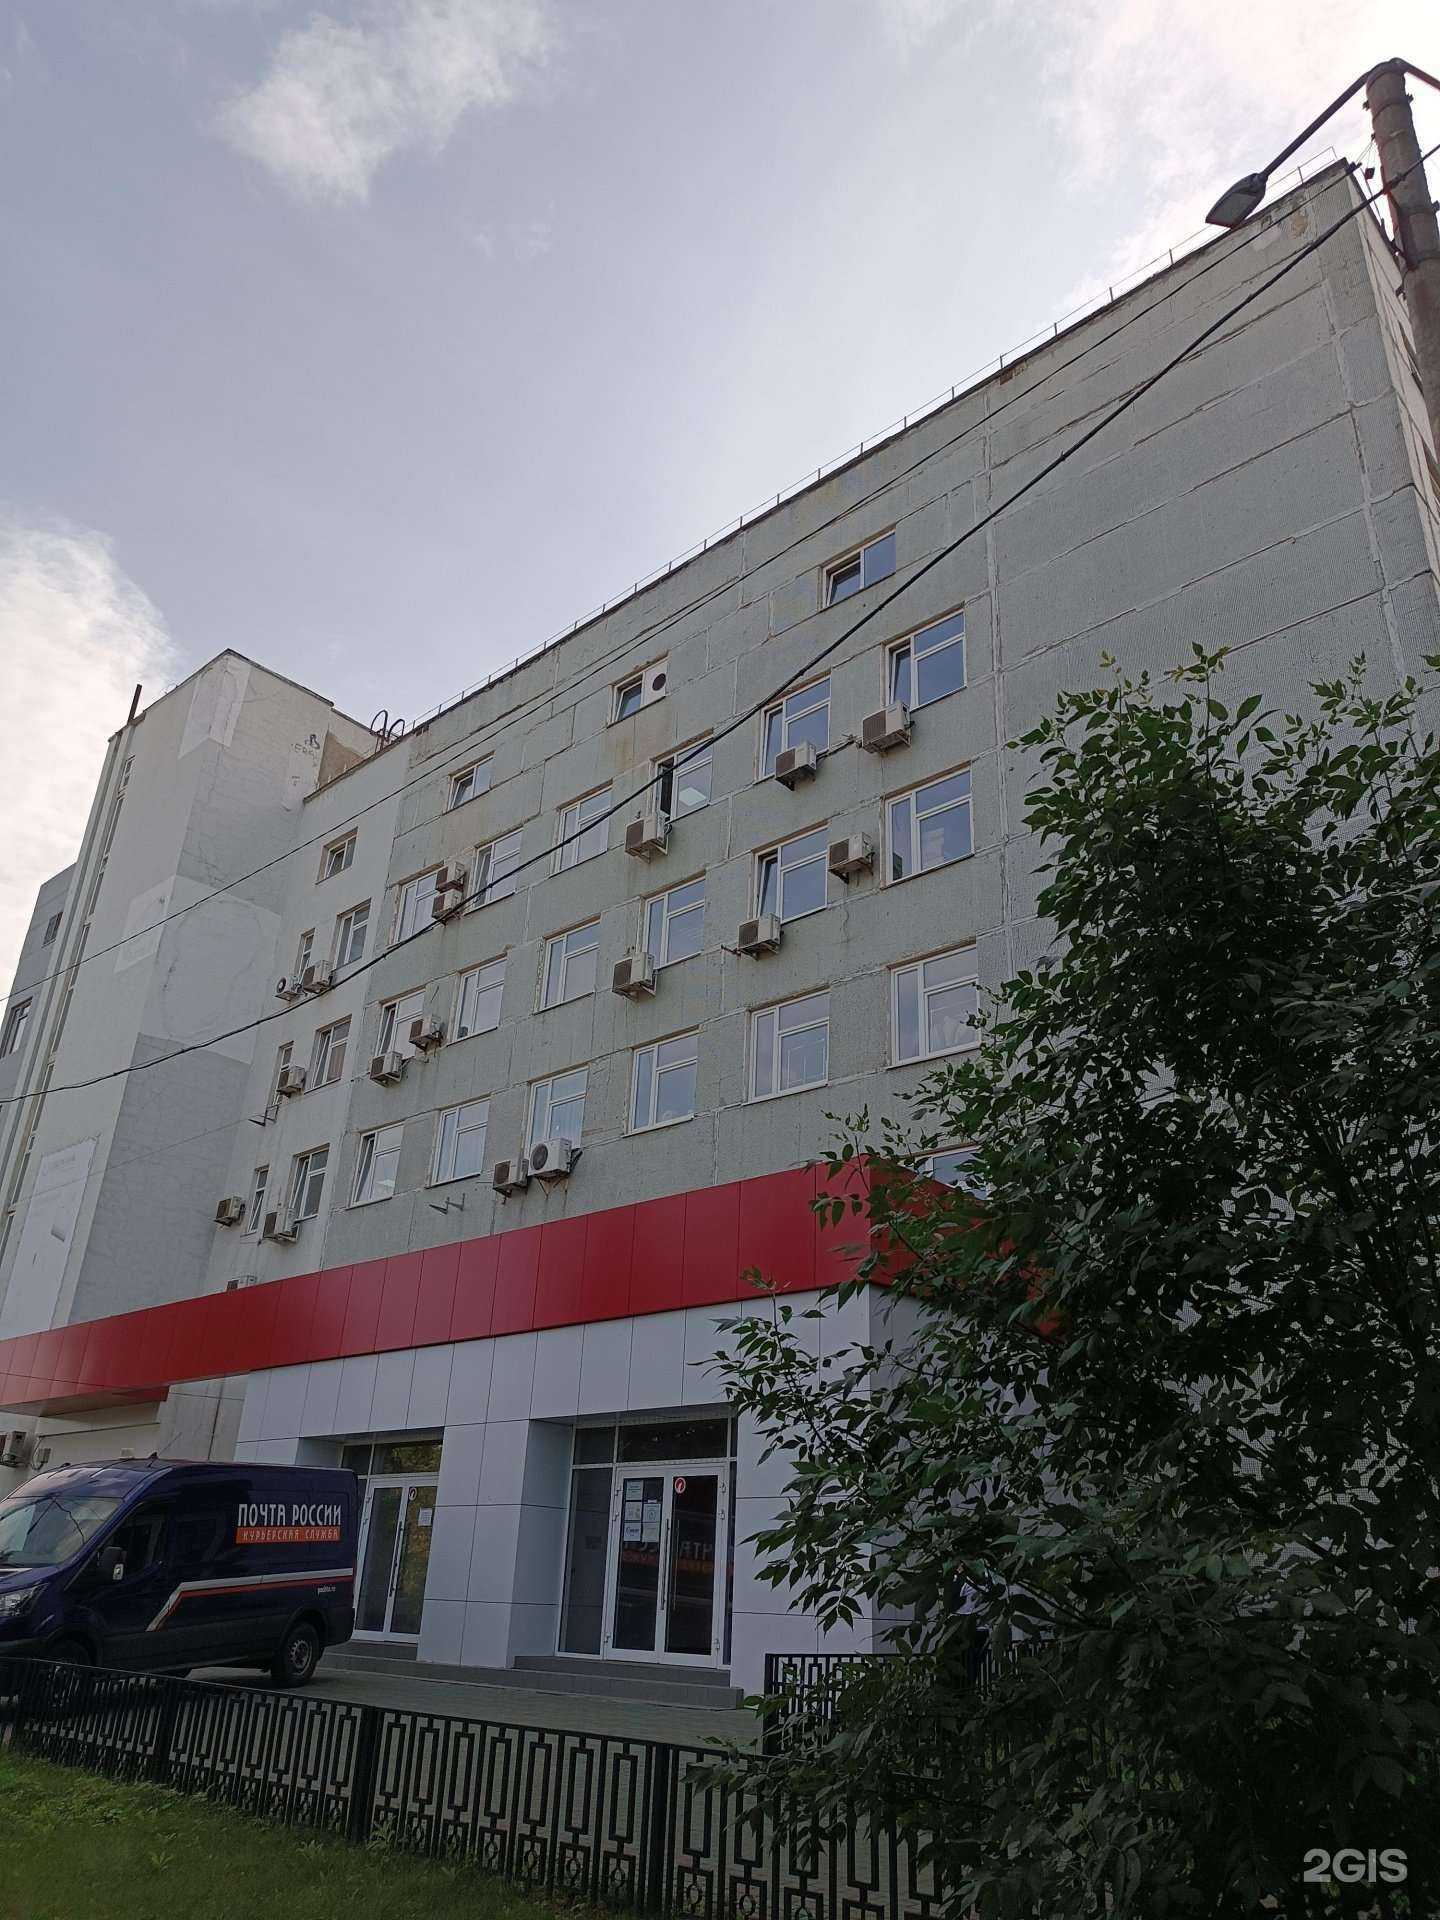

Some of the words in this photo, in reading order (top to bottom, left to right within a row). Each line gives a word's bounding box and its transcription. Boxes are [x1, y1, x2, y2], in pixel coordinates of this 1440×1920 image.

[238, 1503, 286, 1526] ПОЧТА
[291, 1504, 342, 1526] РОССИИ
[243, 1529, 299, 1541] КУРЬЕРСКАЯ
[305, 1529, 338, 1540] СЛУЖБА
